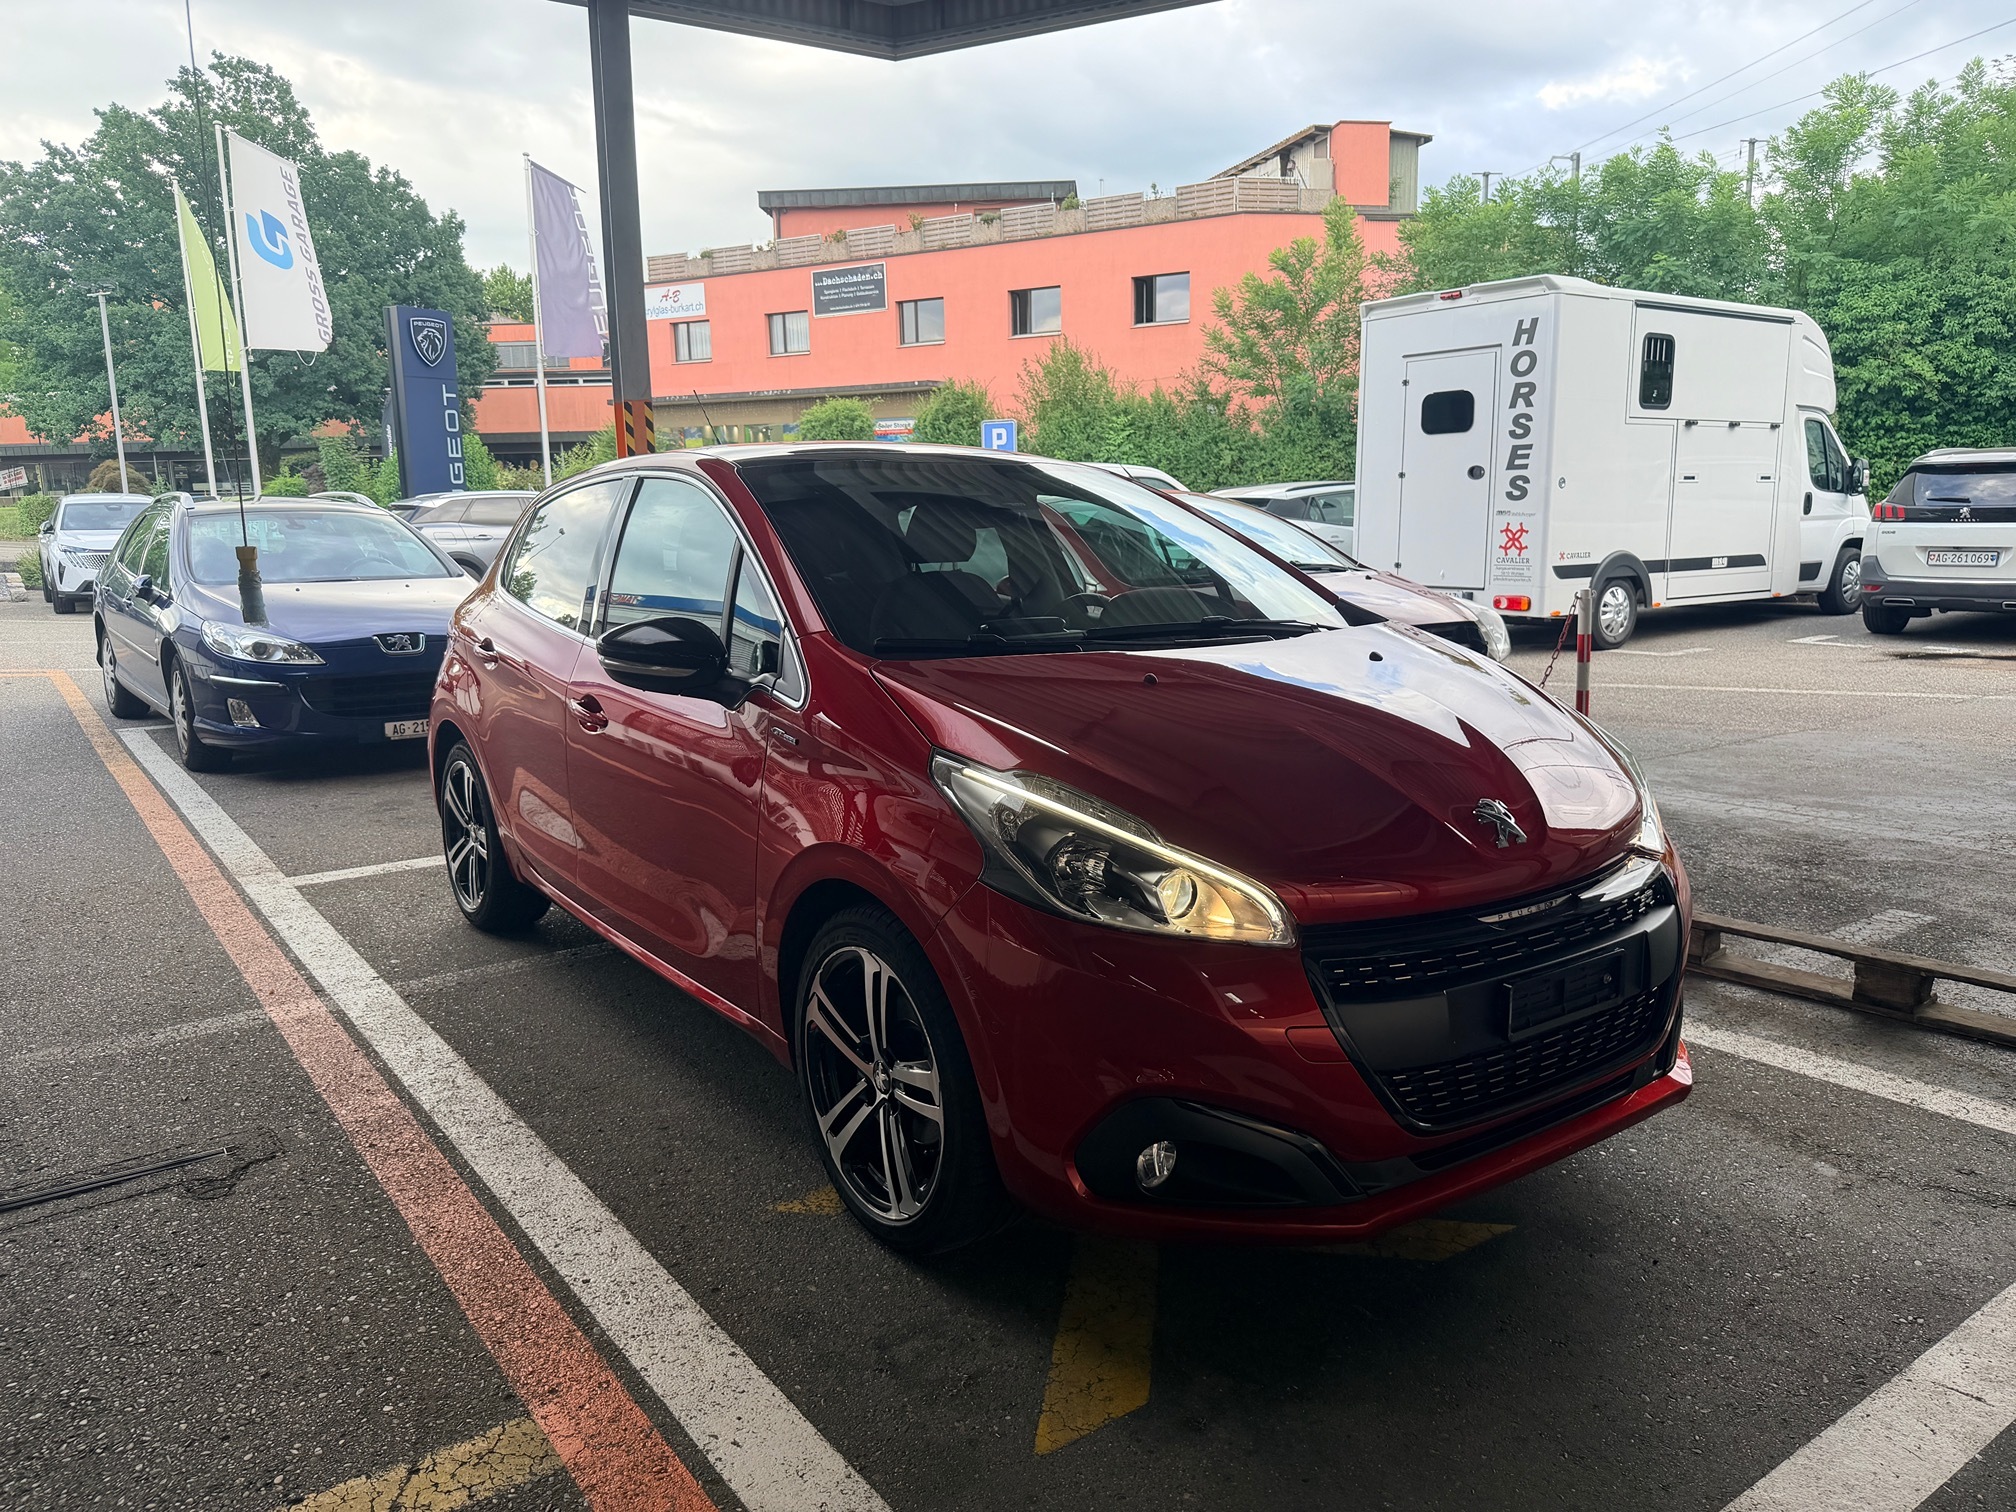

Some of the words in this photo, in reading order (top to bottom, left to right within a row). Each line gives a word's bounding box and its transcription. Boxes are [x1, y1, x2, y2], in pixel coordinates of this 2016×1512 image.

[280, 166, 313, 263] GARAGE
[305, 266, 332, 344] GROSS
[413, 321, 444, 329] PEUGEOT
[442, 384, 465, 492] GEOT
[992, 428, 1007, 449] P
[1505, 317, 1539, 501] HORSES
[1566, 551, 1591, 560] CAVALIER
